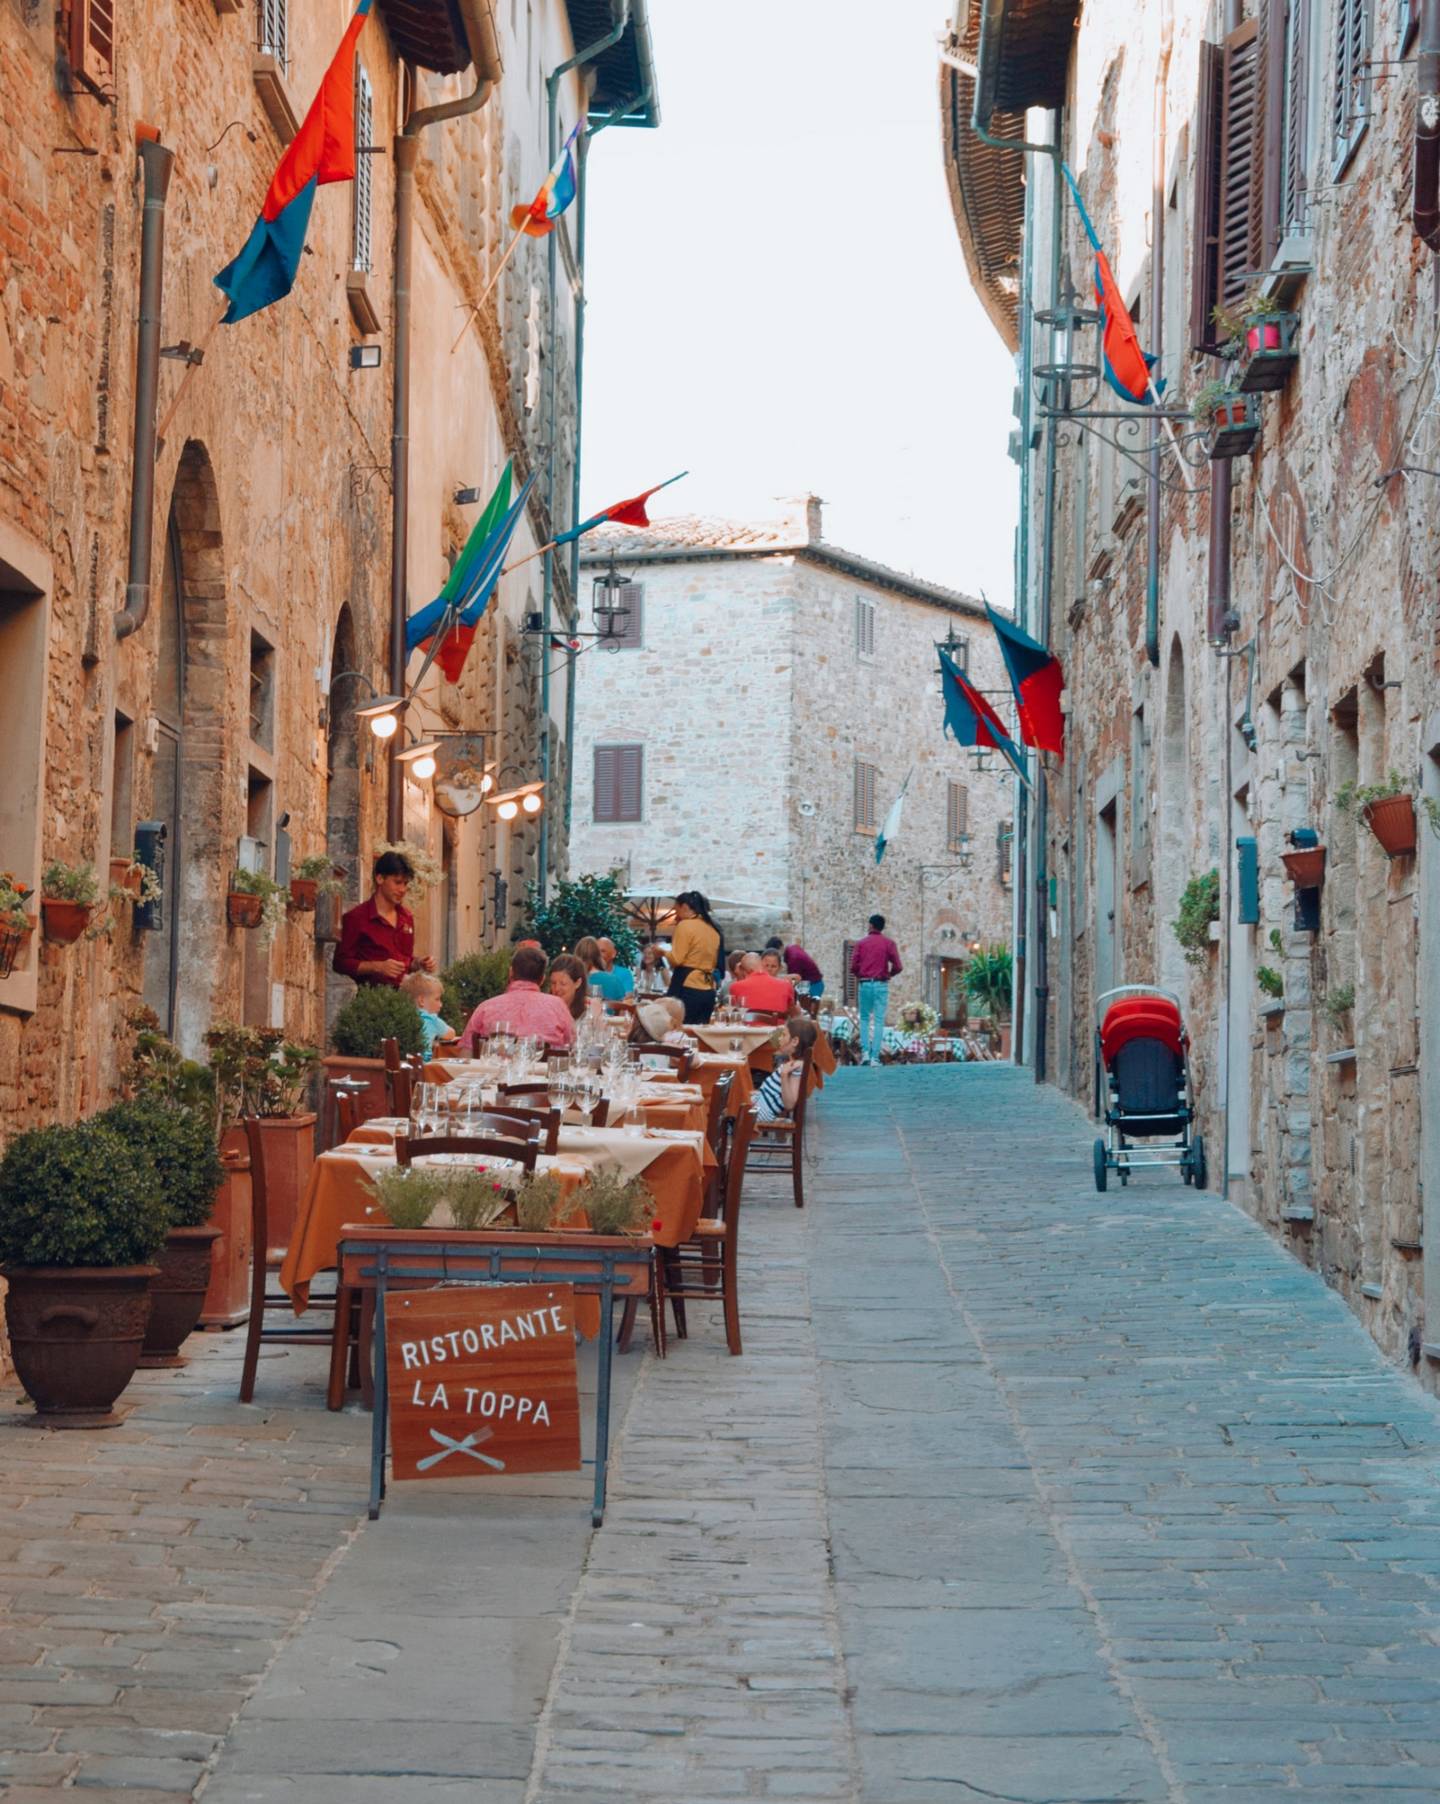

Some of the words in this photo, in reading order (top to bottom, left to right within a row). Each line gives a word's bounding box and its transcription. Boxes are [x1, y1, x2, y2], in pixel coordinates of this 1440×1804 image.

[401, 1306, 567, 1369] RISTORANTE
[412, 1379, 449, 1410] LA
[463, 1388, 550, 1427] TOPPA
